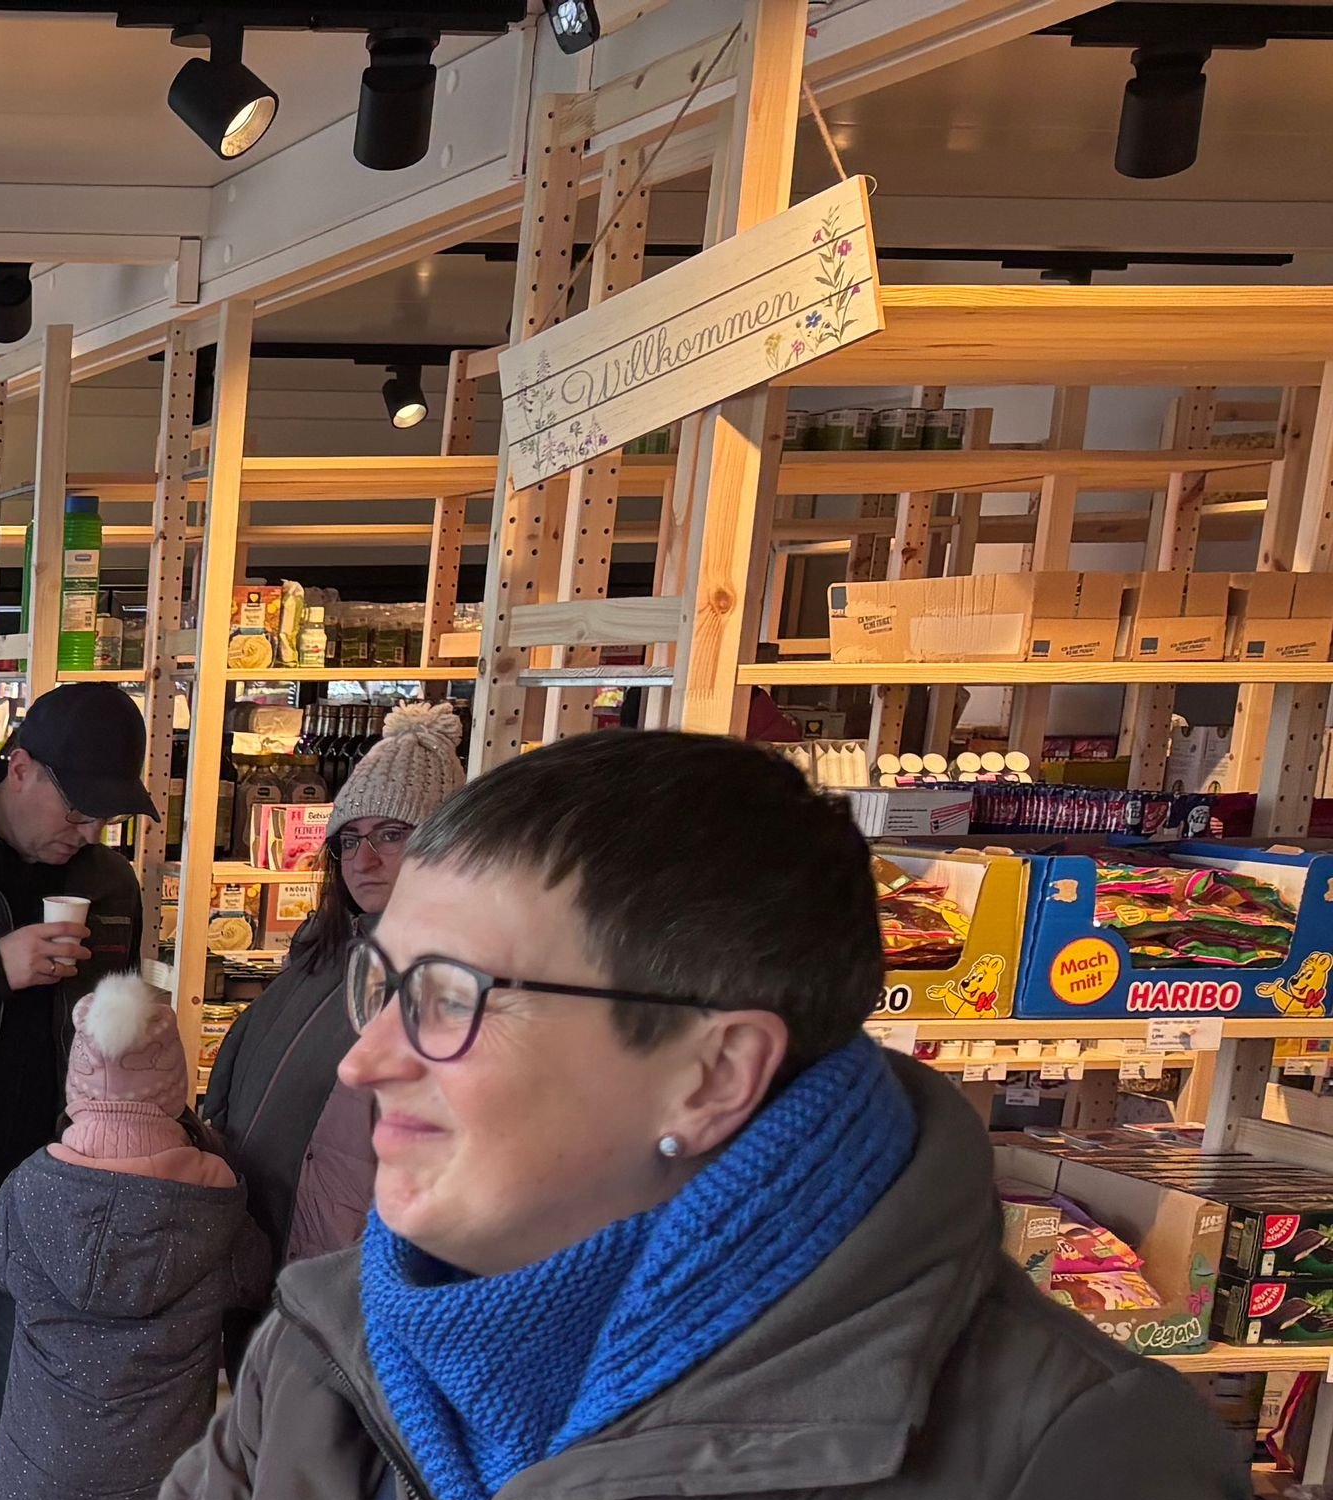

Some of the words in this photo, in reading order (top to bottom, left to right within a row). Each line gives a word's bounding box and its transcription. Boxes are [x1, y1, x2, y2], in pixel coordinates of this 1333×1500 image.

[561, 290, 800, 406] Willkommen
[1060, 952, 1109, 976] Mach
[1070, 972, 1103, 993] mit!
[1128, 982, 1241, 1011] HARIBO
